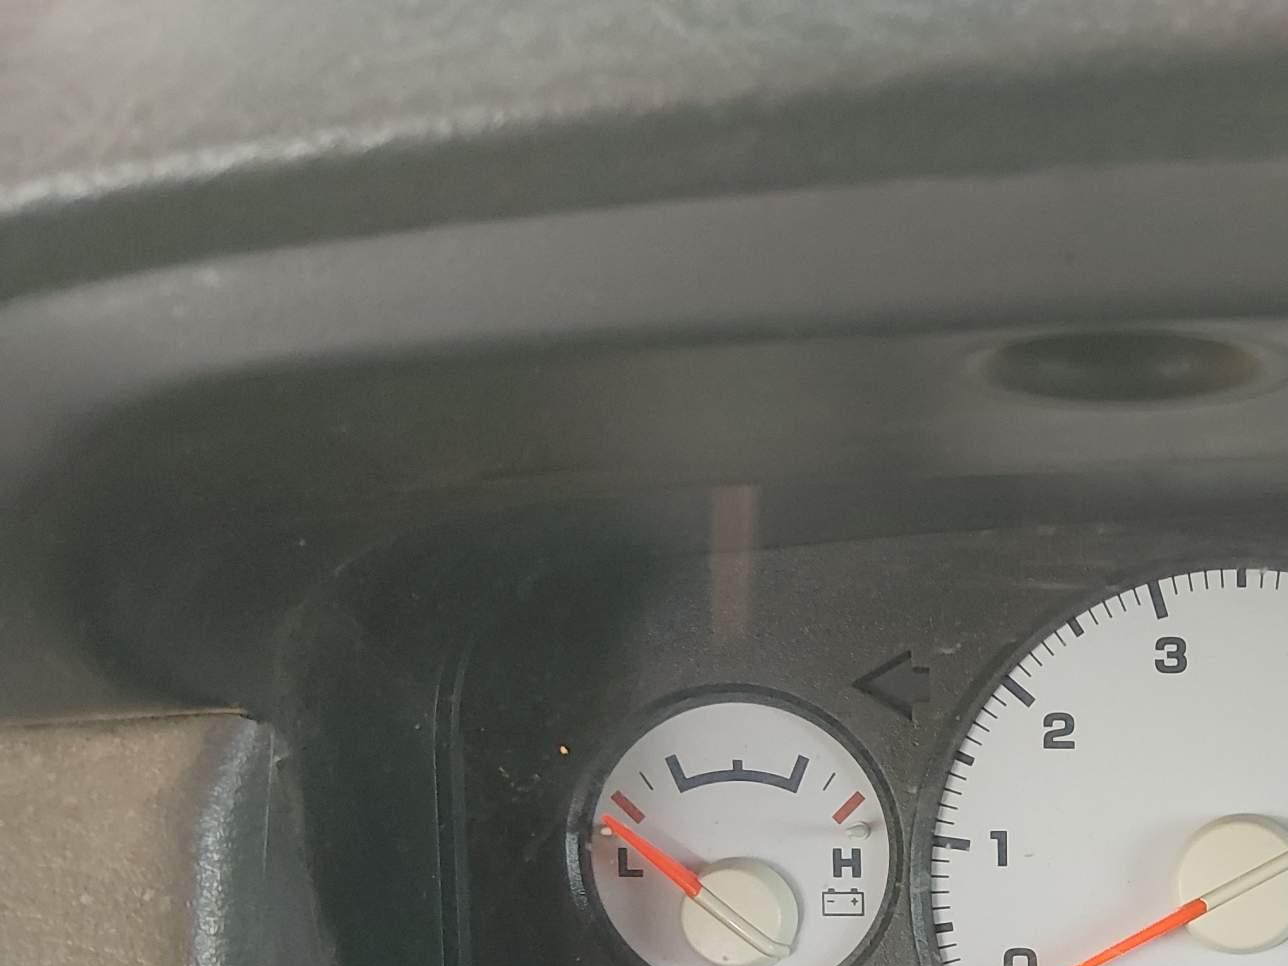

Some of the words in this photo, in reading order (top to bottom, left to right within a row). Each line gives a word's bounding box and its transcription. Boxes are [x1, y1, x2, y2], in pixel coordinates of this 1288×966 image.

[1155, 637, 1187, 673] 3
[1043, 713, 1076, 749] 2
[618, 848, 643, 877] L
[833, 848, 861, 878] H
[989, 830, 1008, 867] 1
